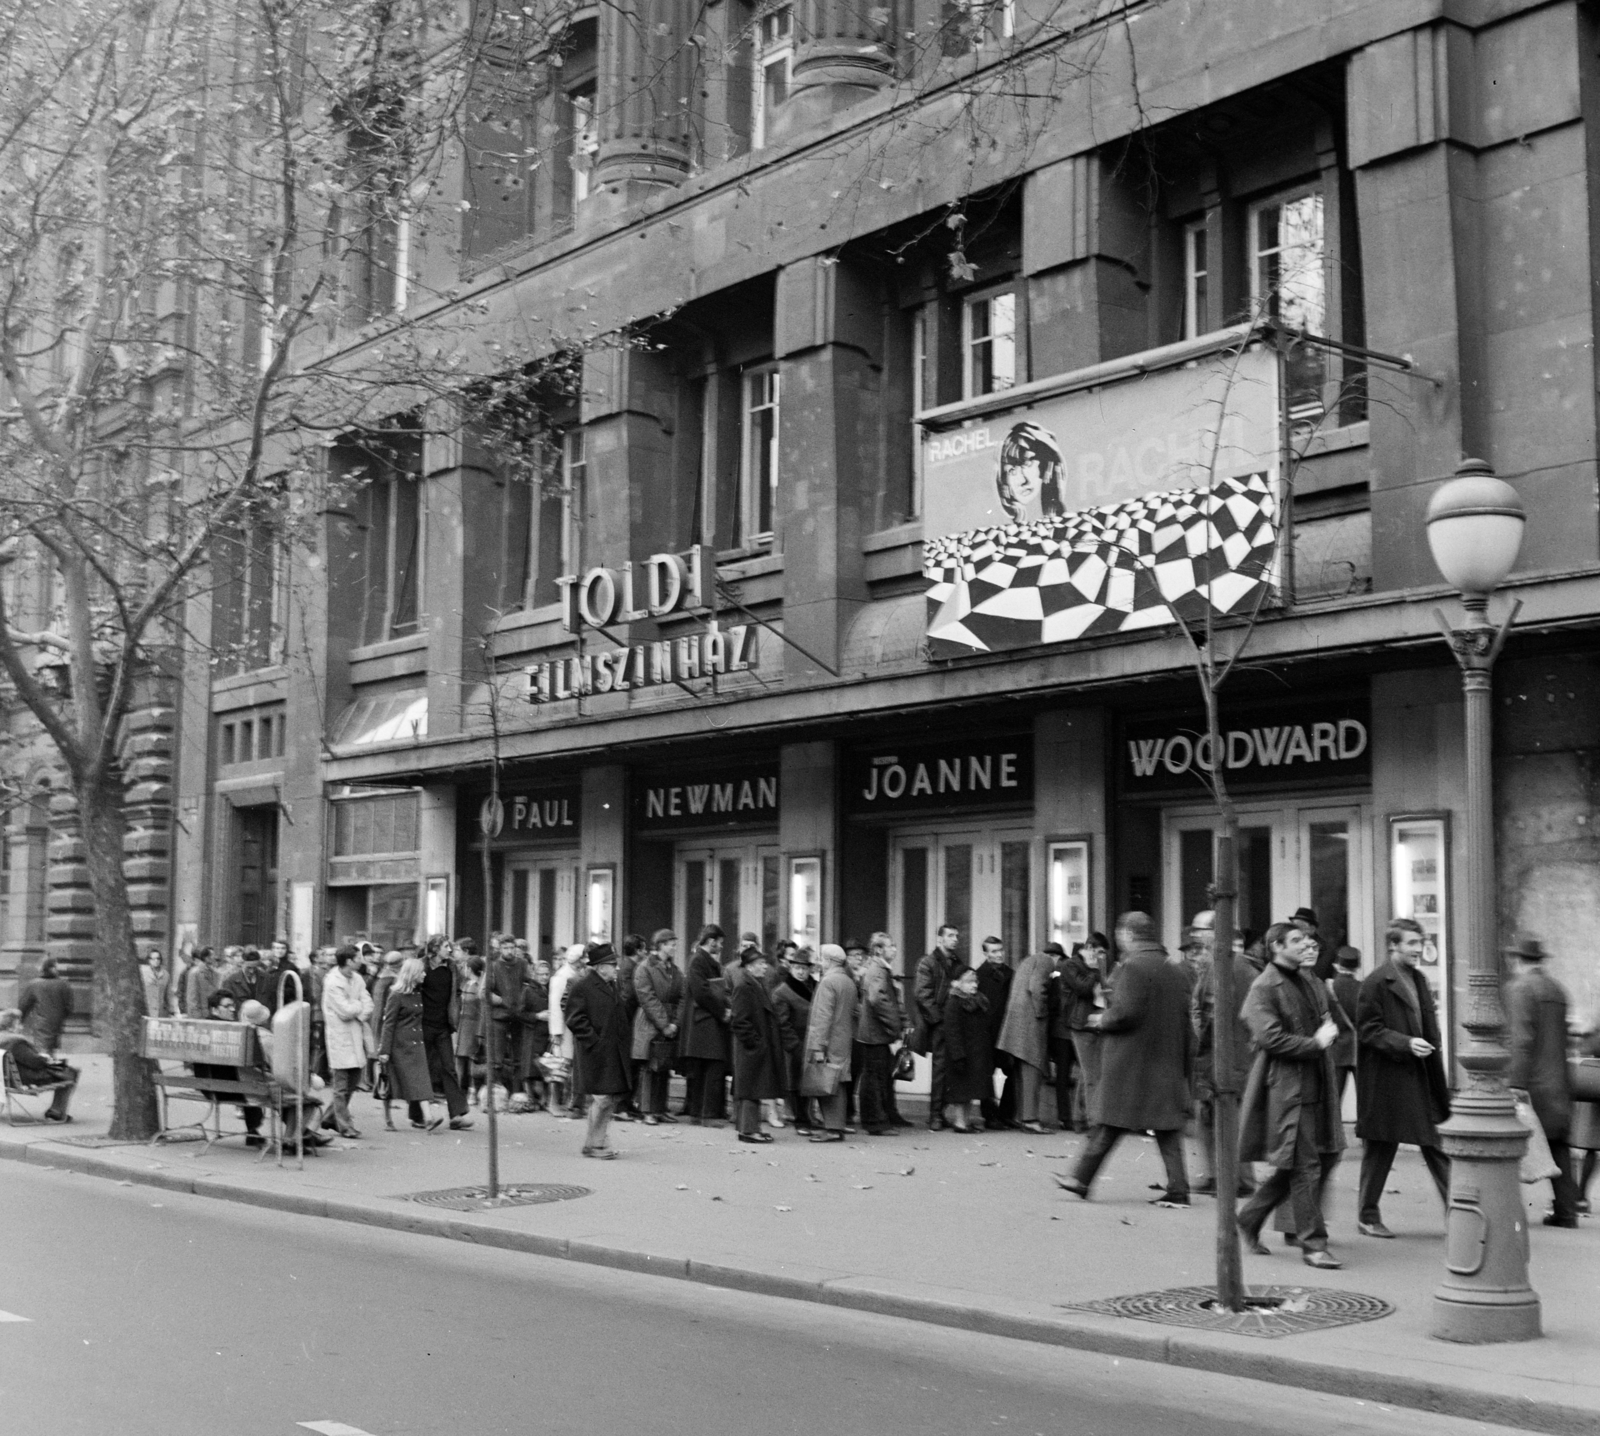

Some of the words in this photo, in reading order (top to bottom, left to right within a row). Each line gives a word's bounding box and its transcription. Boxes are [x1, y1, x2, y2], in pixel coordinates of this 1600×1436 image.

[553, 544, 701, 632] TOLDI
[1128, 719, 1368, 777] WOODWARD
[646, 777, 777, 818] NEWMAN
[863, 754, 1018, 801] JOANNE
[511, 799, 574, 830] PAUL
